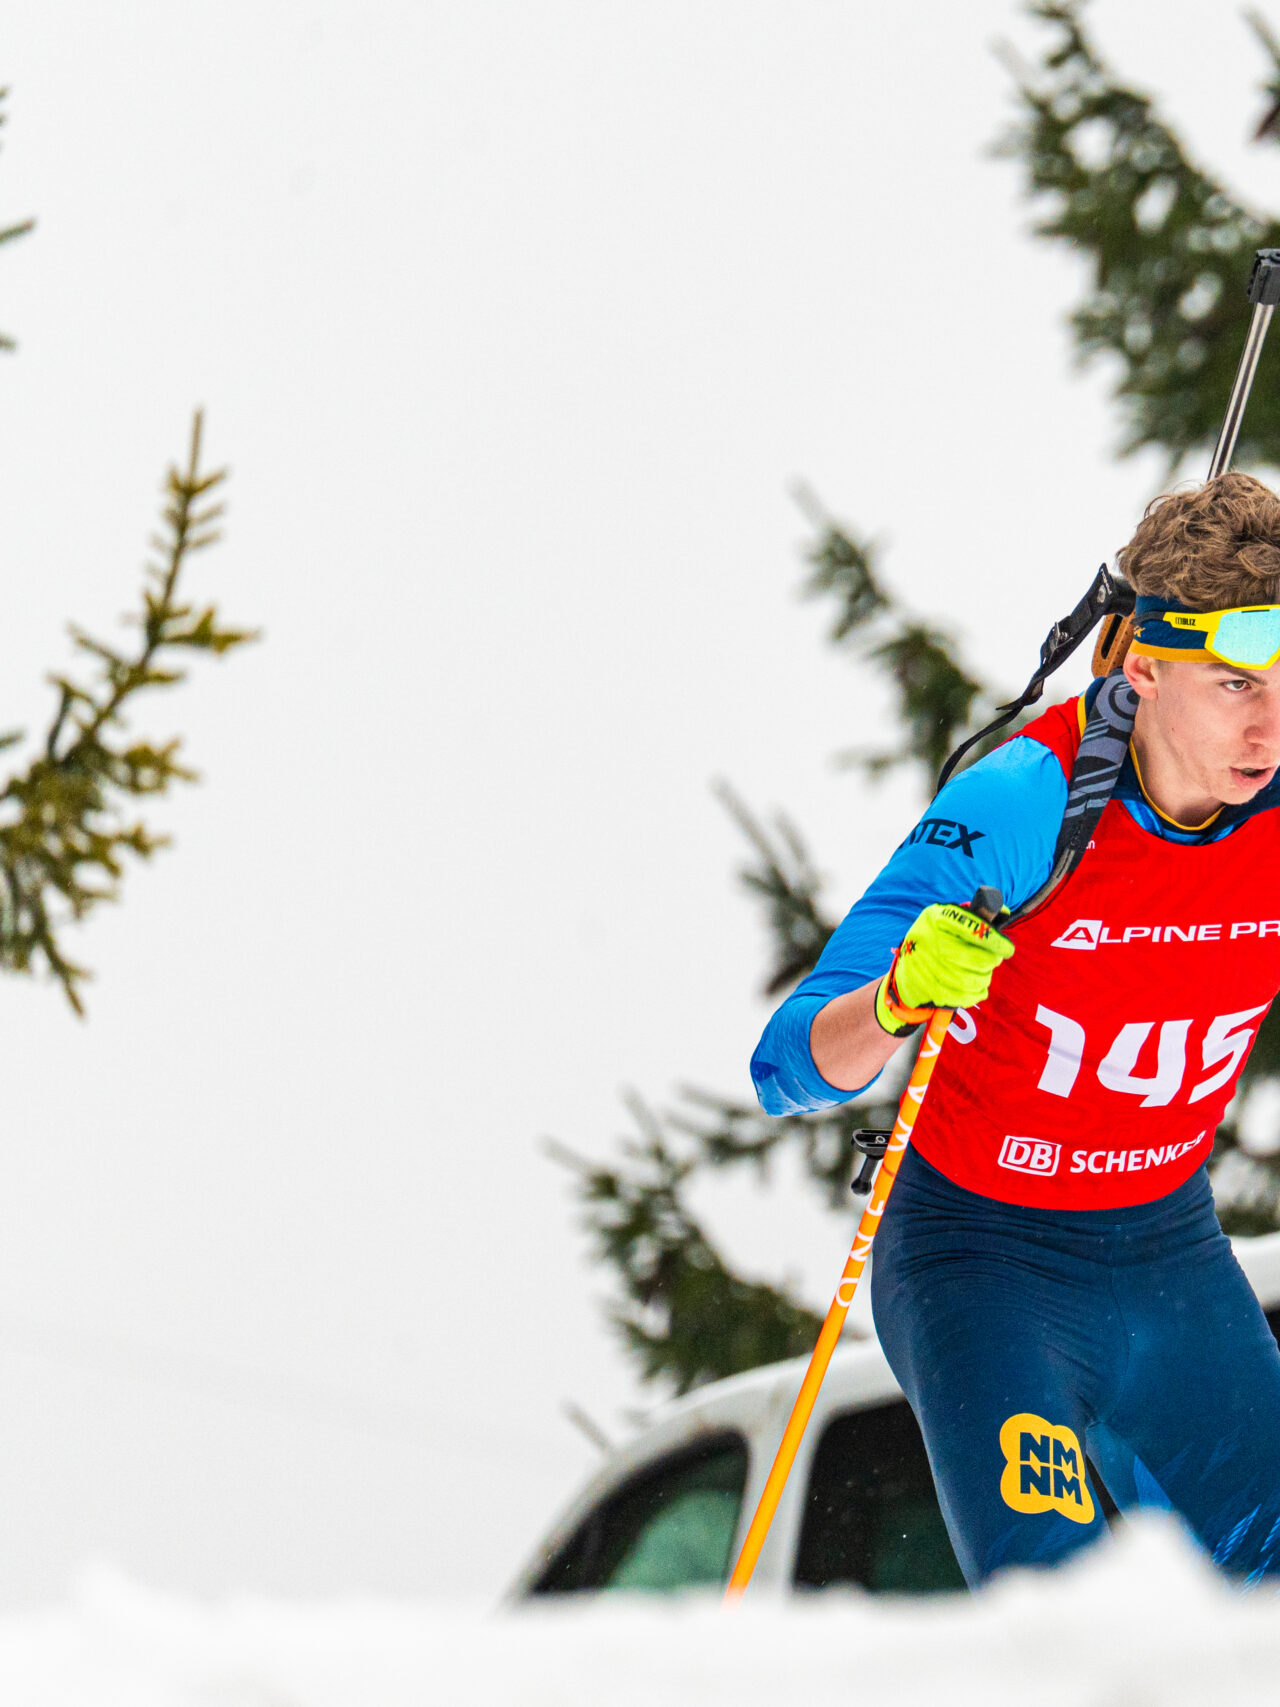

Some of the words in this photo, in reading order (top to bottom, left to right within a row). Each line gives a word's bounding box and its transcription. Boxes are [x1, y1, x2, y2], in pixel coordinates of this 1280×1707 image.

[1050, 919, 1223, 950] ALPINE
[1034, 999, 1274, 1108] 145
[1004, 1139, 1056, 1171] DB
[1019, 1431, 1080, 1477] NM
[1019, 1463, 1084, 1507] NM
